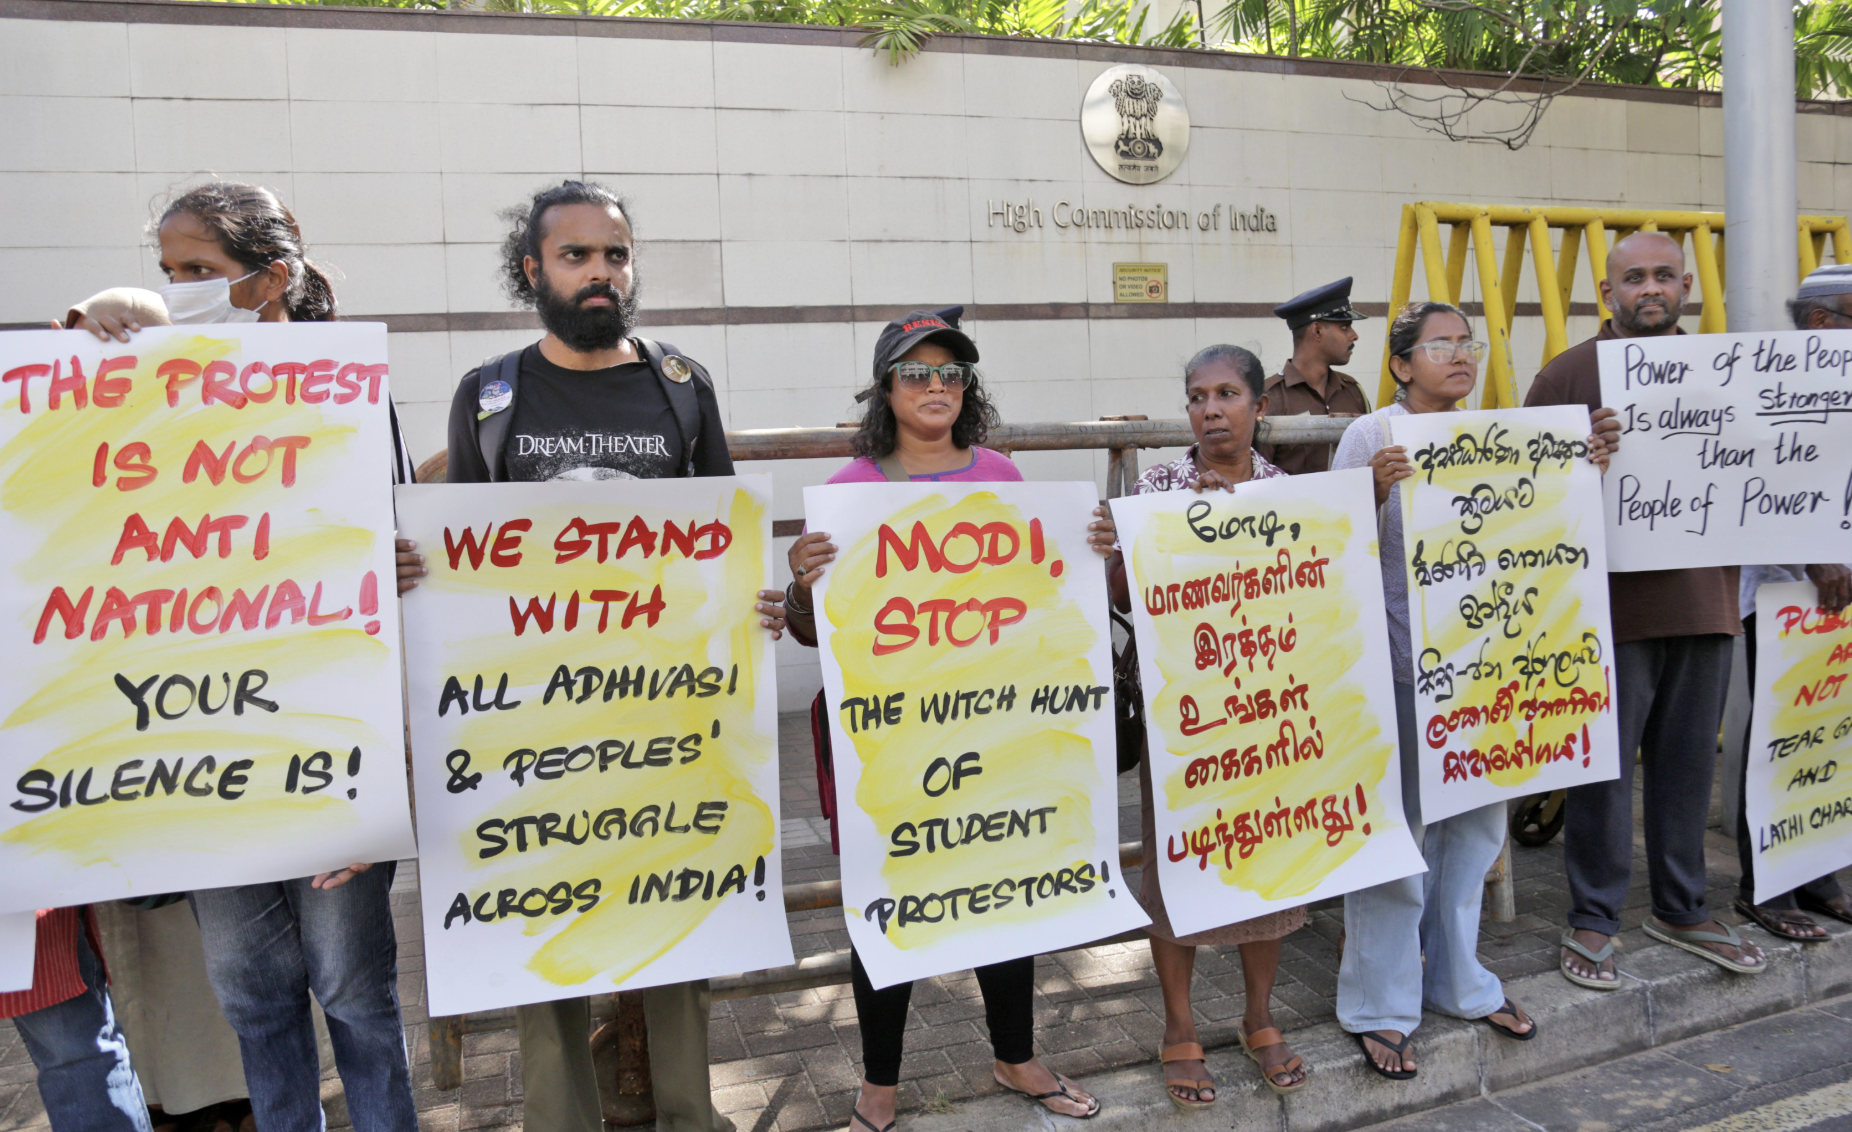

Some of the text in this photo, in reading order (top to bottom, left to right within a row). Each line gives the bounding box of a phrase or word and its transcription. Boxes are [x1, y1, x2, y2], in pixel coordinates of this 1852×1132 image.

[987, 199, 1278, 233] High Commission of India
[1, 355, 389, 414] THE PROTEST
[1625, 343, 1689, 391] Power
[1713, 342, 1741, 387] of
[1752, 338, 1797, 373] the
[516, 433, 672, 457] DREAM THEATER
[1622, 403, 1652, 435] Is
[1658, 397, 1735, 441] always
[92, 435, 312, 492] IS NOT
[1697, 431, 1819, 470] than the
[1618, 474, 1682, 532] People
[1685, 482, 1715, 536] of
[1739, 476, 1830, 527] Power
[110, 512, 271, 566] ANTI
[444, 514, 733, 571] WE STAND
[32, 570, 381, 645] NATIONAL!
[509, 584, 666, 637] WITH
[872, 596, 1028, 657] STOP
[113, 669, 280, 732] YOUR
[438, 663, 739, 718] ALL ADHIVASI
[840, 684, 1110, 734] THE WITCH HUNT
[1179, 673, 1310, 737] உங்கள்
[1794, 673, 1849, 707] NOT
[445, 748, 483, 794] &
[1184, 715, 1324, 789] கைகளில்
[1767, 725, 1826, 763] TEAR
[9, 745, 362, 813] SILENCE IS!
[922, 751, 983, 798] OF
[1786, 759, 1838, 792] AND
[475, 800, 729, 860] STRUGGLE
[888, 806, 1058, 858] STUDENT
[1759, 814, 1804, 854] LATHI
[443, 854, 766, 930] ACROSS INDIA!
[864, 860, 1117, 935] PROTESTORS!
